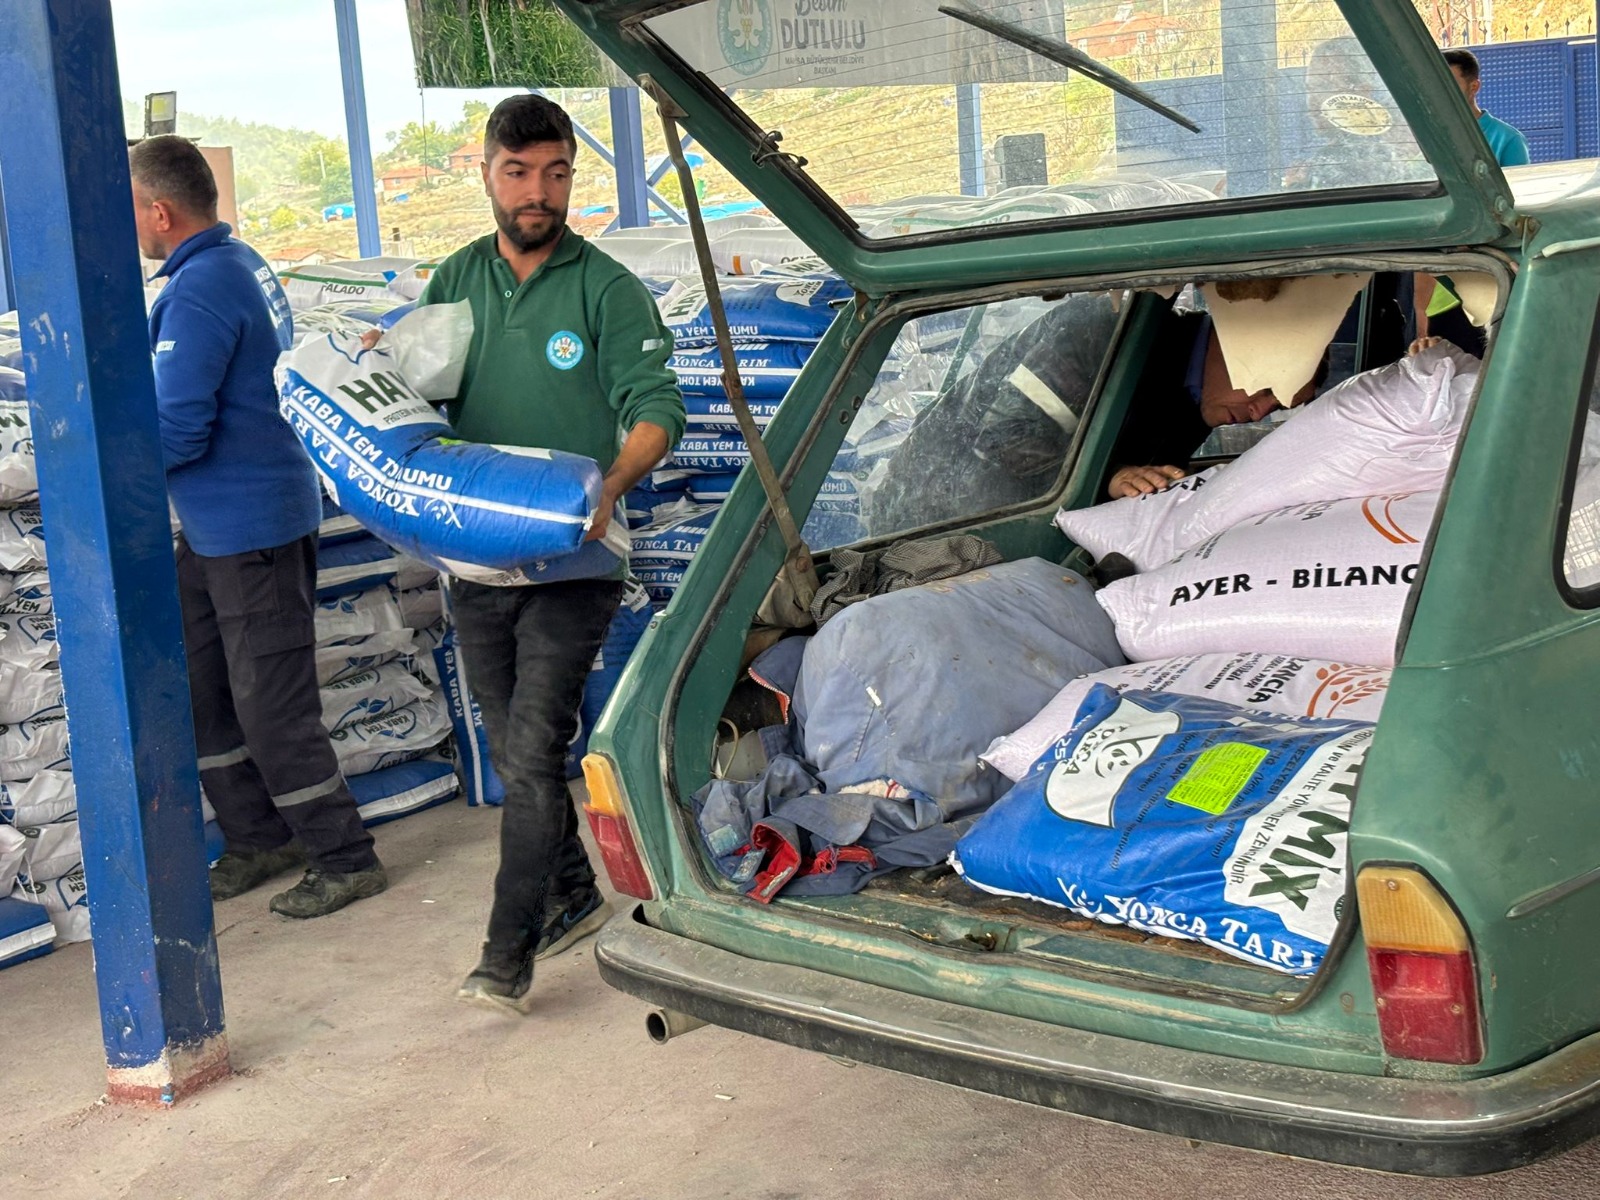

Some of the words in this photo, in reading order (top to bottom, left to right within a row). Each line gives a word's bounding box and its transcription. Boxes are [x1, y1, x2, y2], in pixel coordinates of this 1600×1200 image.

[780, 18, 866, 50] DUTLULU
[685, 327, 708, 336] YEM
[711, 325, 758, 335] THUMU
[672, 356, 715, 367] YONCA
[749, 405, 762, 414] EM
[280, 403, 342, 470] TARI
[292, 385, 344, 431] KABA
[344, 426, 384, 462] YEM
[380, 457, 453, 491] TOUMU
[703, 423, 740, 431] ARIM
[680, 441, 709, 450] KABA
[712, 441, 734, 450] YEM
[723, 457, 749, 467] NCA
[347, 460, 421, 518] YONCA
[1169, 573, 1253, 607] AYER
[1292, 562, 1420, 589] BİLANC
[16, 598, 41, 613] YEM
[448, 679, 464, 718] KABA
[385, 714, 411, 727] KABA
[1333, 751, 1345, 763] ve
[1302, 763, 1338, 792] KALİTE
[1266, 792, 1312, 832] YÖNDEN
[1105, 894, 1207, 937] YONCA
[1220, 917, 1323, 969] TARI
